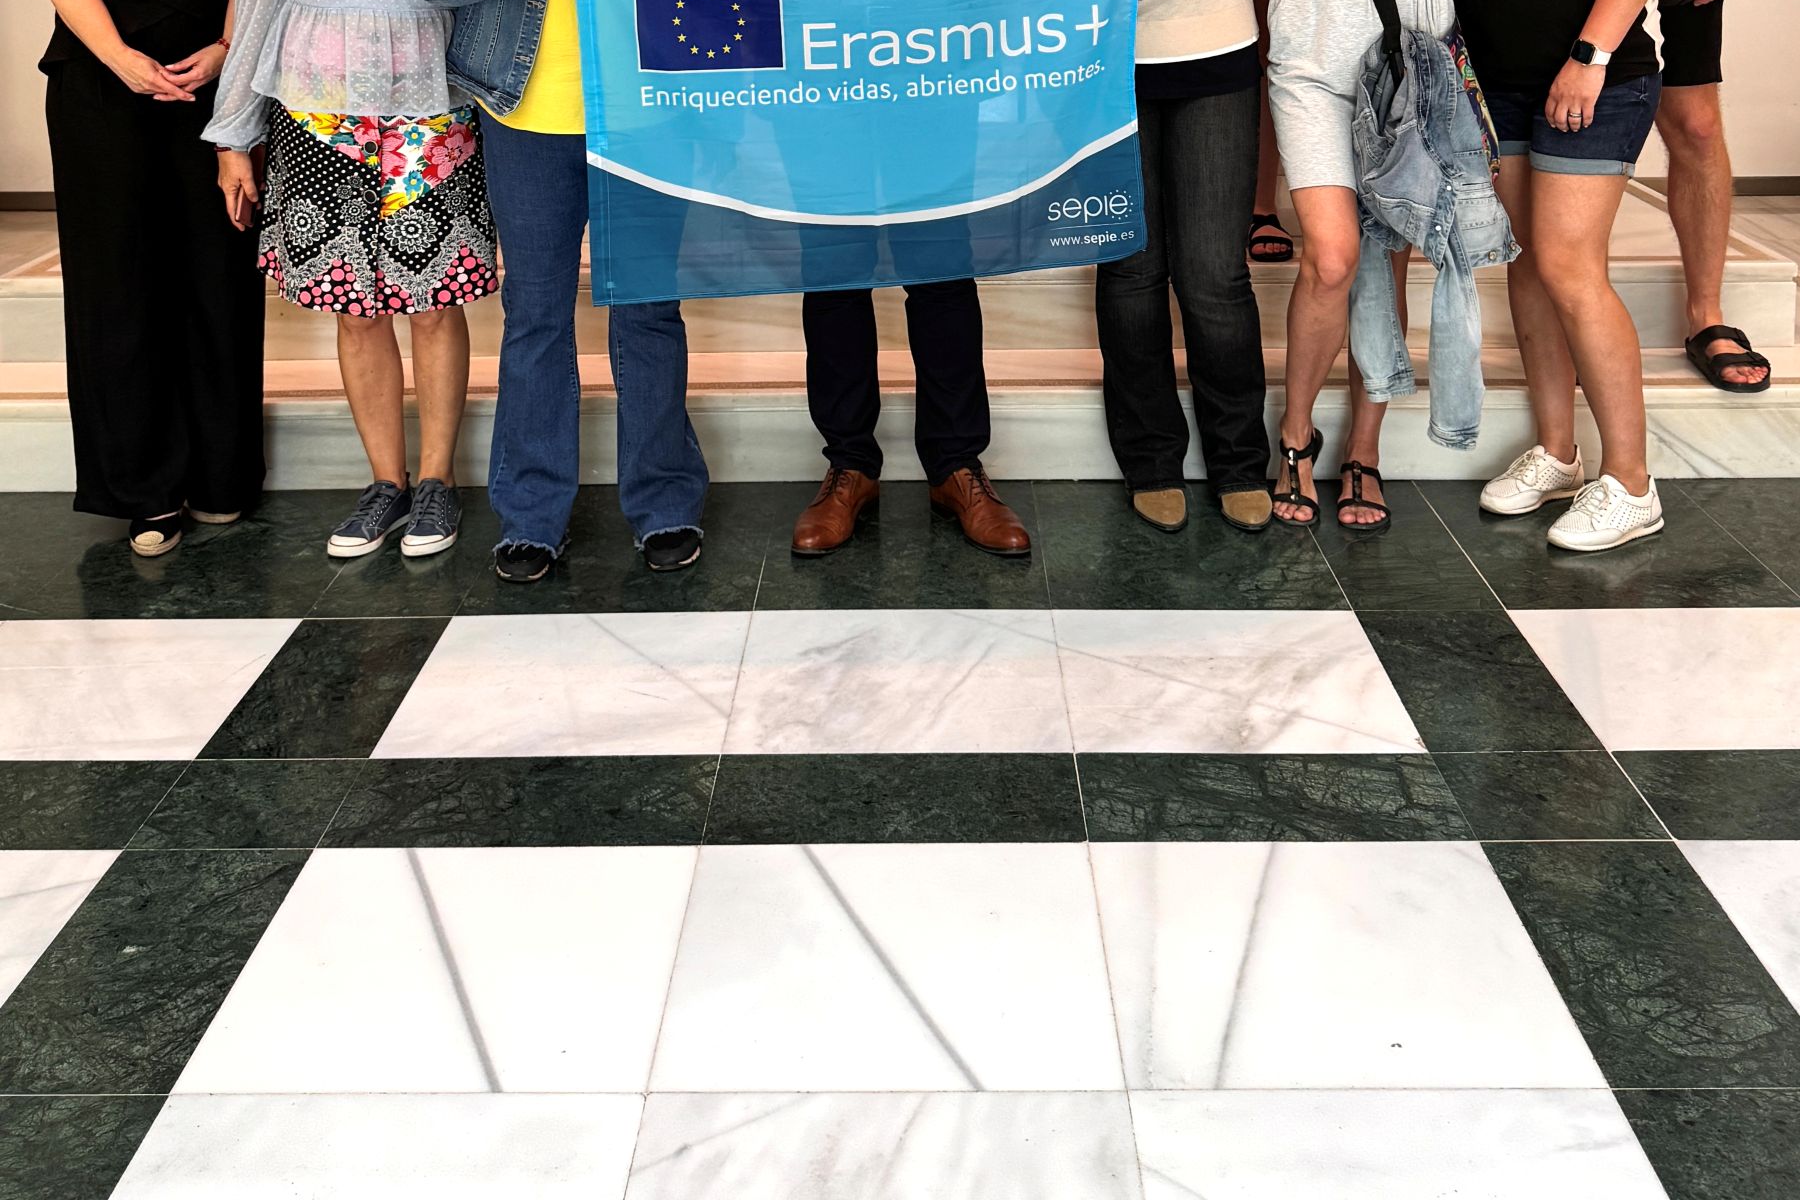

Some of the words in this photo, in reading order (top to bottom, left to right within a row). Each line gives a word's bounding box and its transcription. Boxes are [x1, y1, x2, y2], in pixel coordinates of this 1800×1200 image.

[640, 80, 821, 113] Enriqueciendo
[827, 77, 898, 101] vidas,
[906, 69, 1017, 98] abriendo
[1025, 58, 1105, 89] mentes.
[1047, 194, 1129, 224] sepie
[1049, 230, 1135, 247] www.sepie.es
